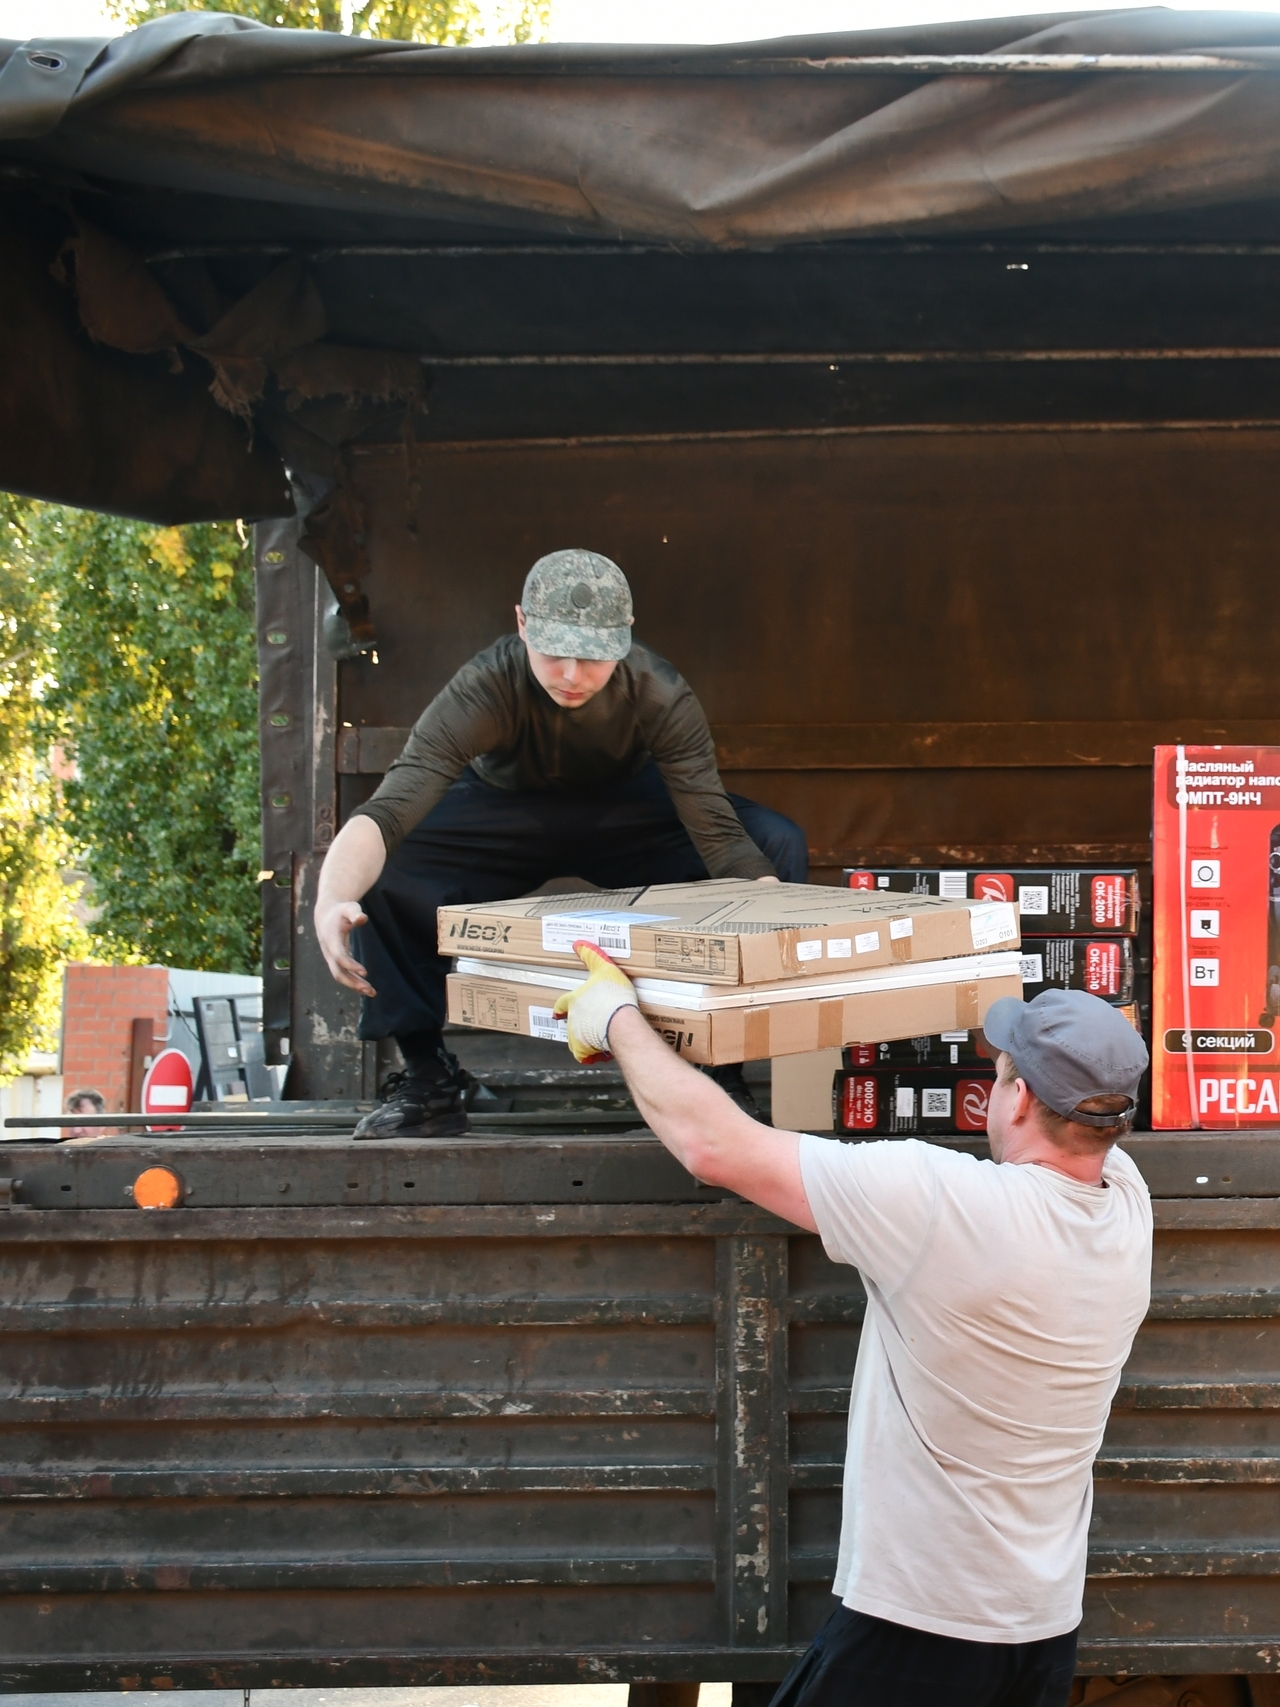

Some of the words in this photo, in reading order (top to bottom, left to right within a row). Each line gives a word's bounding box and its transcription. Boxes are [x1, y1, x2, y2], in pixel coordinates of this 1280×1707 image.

[1175, 791, 1262, 806] ОМПТ-9НЧ
[1195, 966, 1215, 979] Вт
[1196, 1034, 1256, 1050] секций
[863, 1081, 875, 1123] ОК-2000
